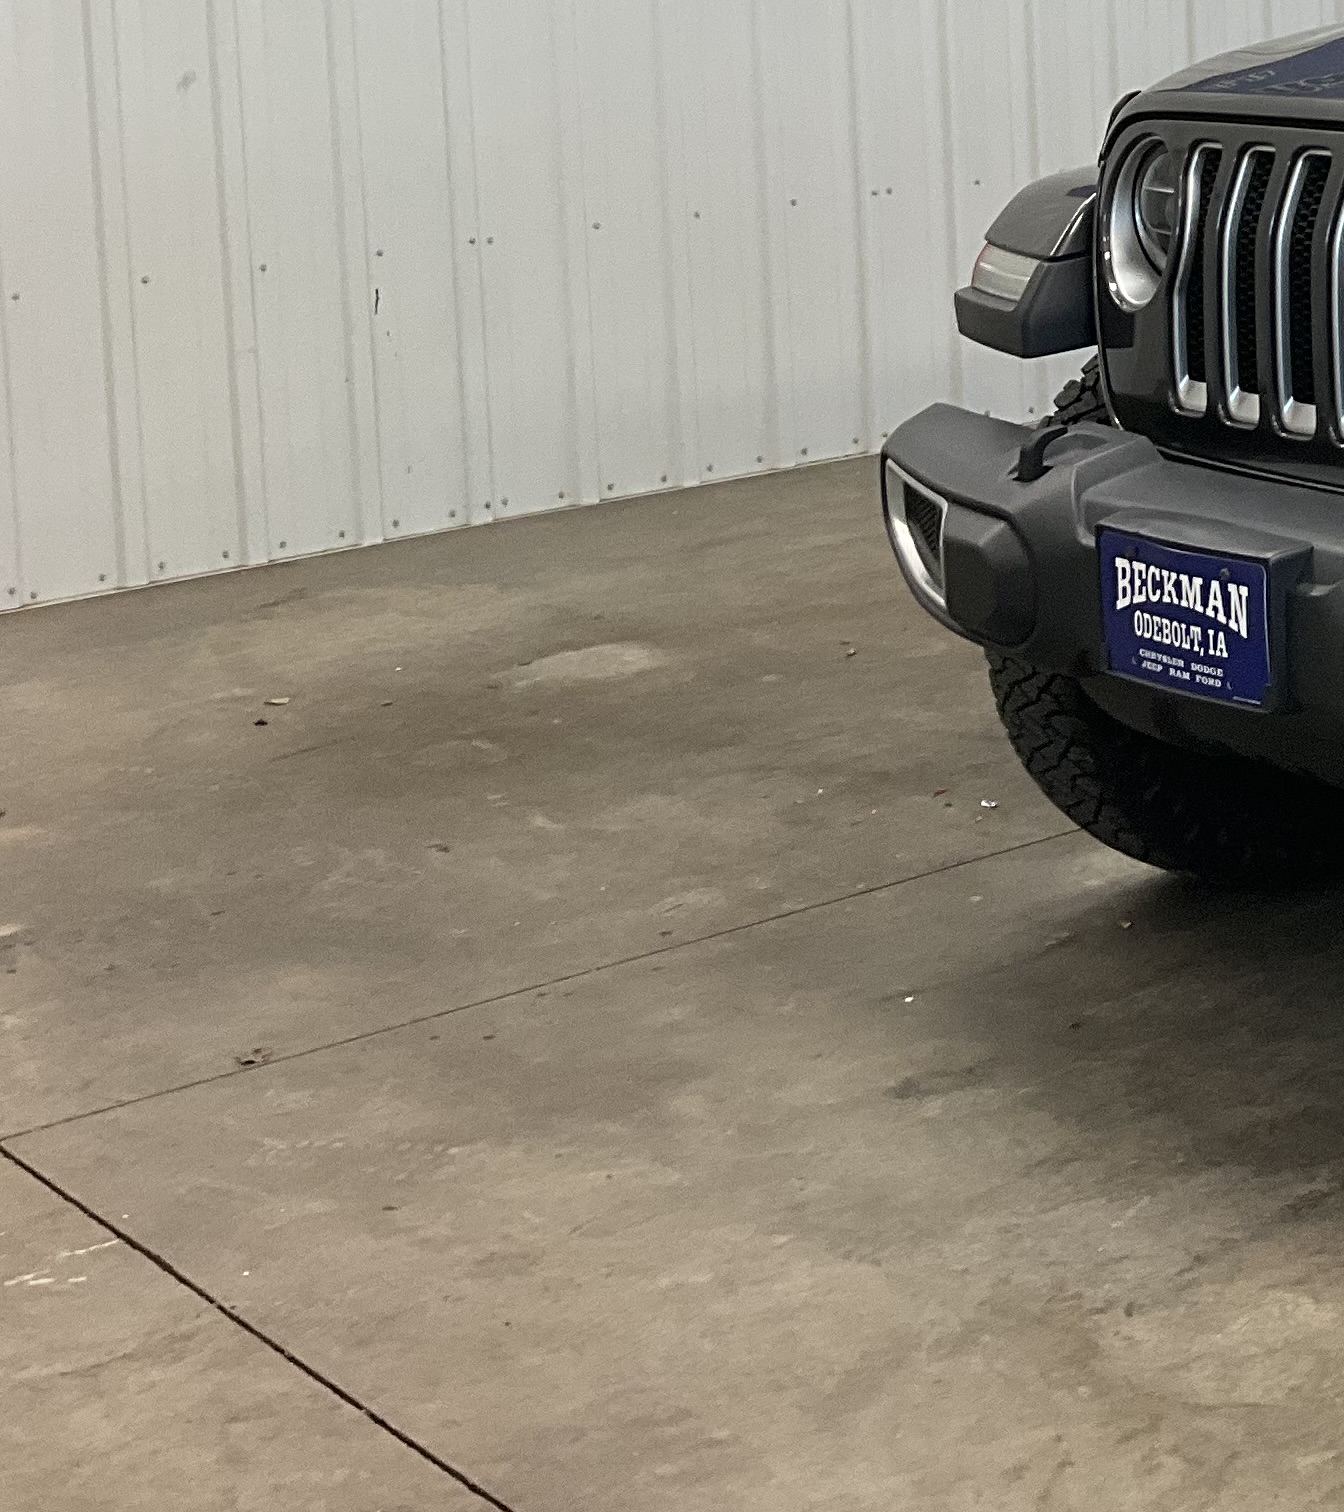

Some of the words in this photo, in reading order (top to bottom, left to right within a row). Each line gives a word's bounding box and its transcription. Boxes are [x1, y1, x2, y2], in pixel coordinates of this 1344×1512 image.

[1115, 556, 1249, 639] BECKMAN
[1133, 609, 1204, 657] ODEBOLT,
[1207, 629, 1229, 658] IA
[1139, 648, 1185, 668] CHRYSLER
[1191, 662, 1224, 677] DODGE
[1141, 660, 1163, 673] JEEP
[1169, 667, 1191, 681] RAM
[1195, 674, 1222, 688] FORD
